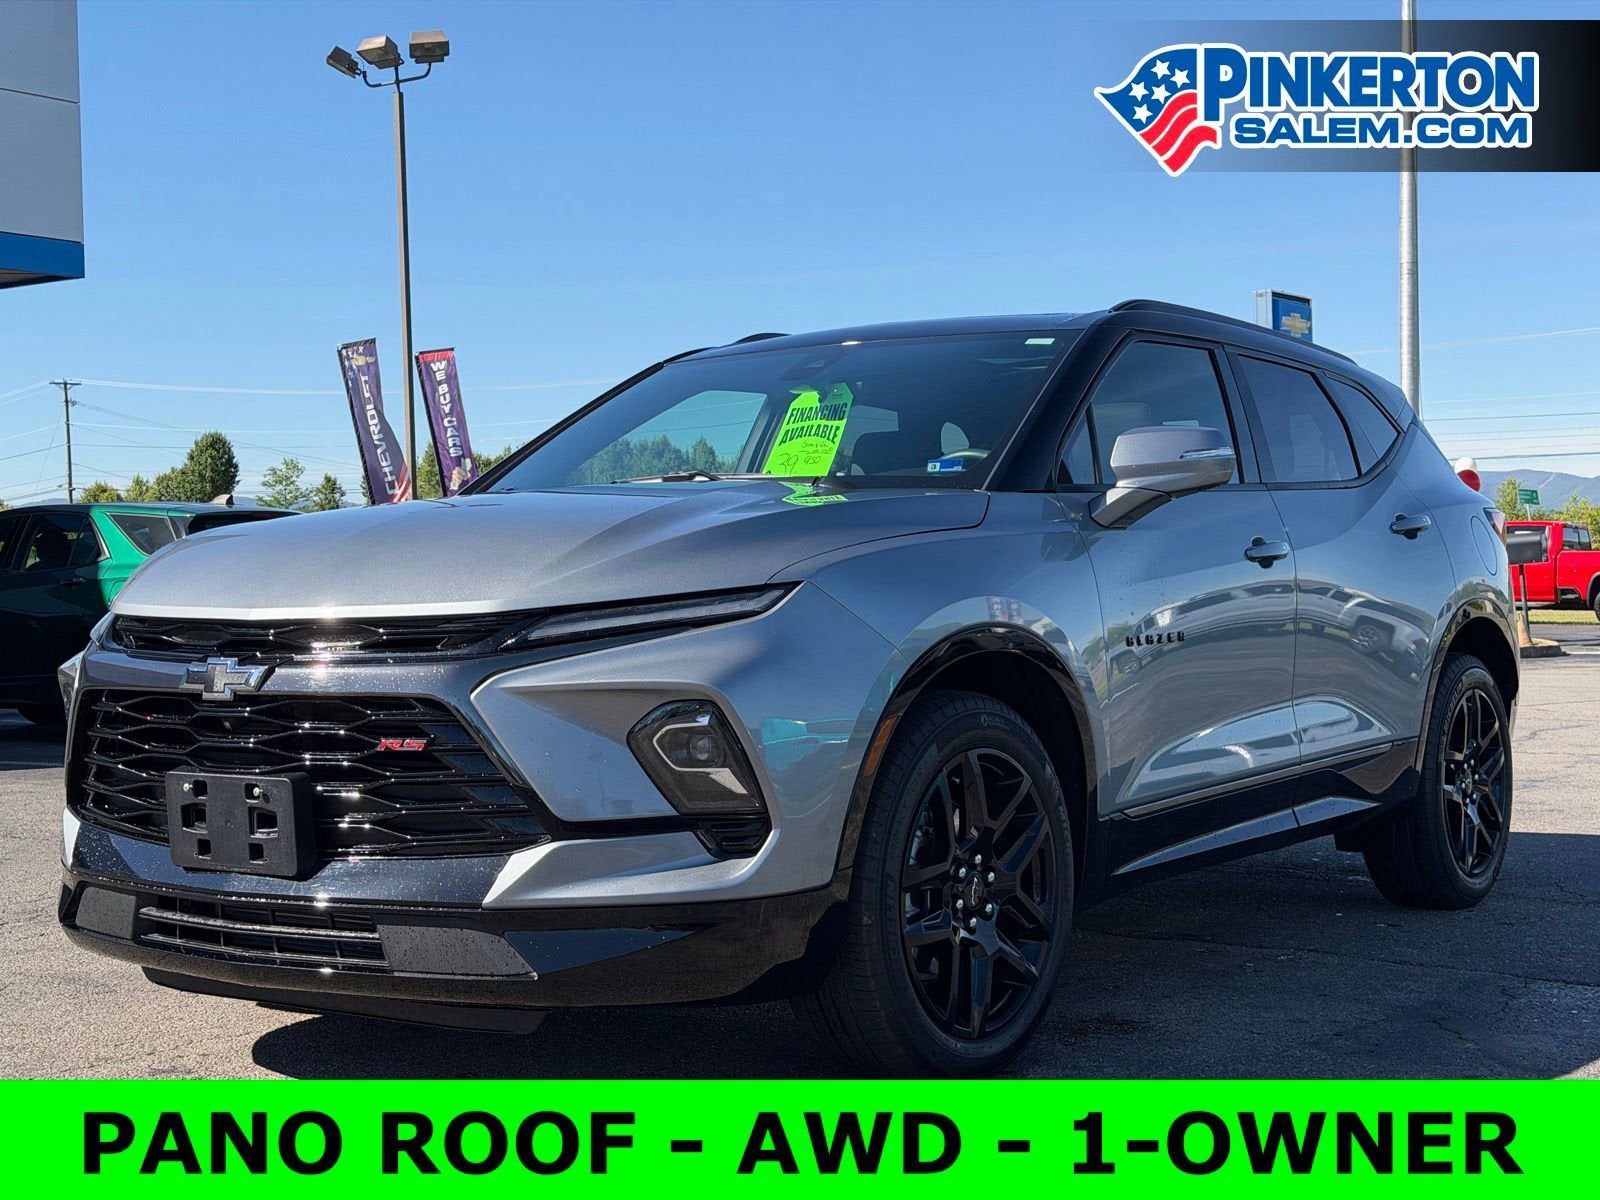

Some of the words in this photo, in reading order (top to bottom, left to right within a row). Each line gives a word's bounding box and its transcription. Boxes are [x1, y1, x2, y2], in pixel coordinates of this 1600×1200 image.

[430, 360, 447, 381] WE
[438, 383, 451, 416] BUY
[786, 402, 848, 426] FINANCING
[443, 417, 463, 457] CARS
[778, 424, 840, 446] AVAILABLE
[1126, 631, 1185, 648] BLAZER
[376, 738, 427, 752] RS
